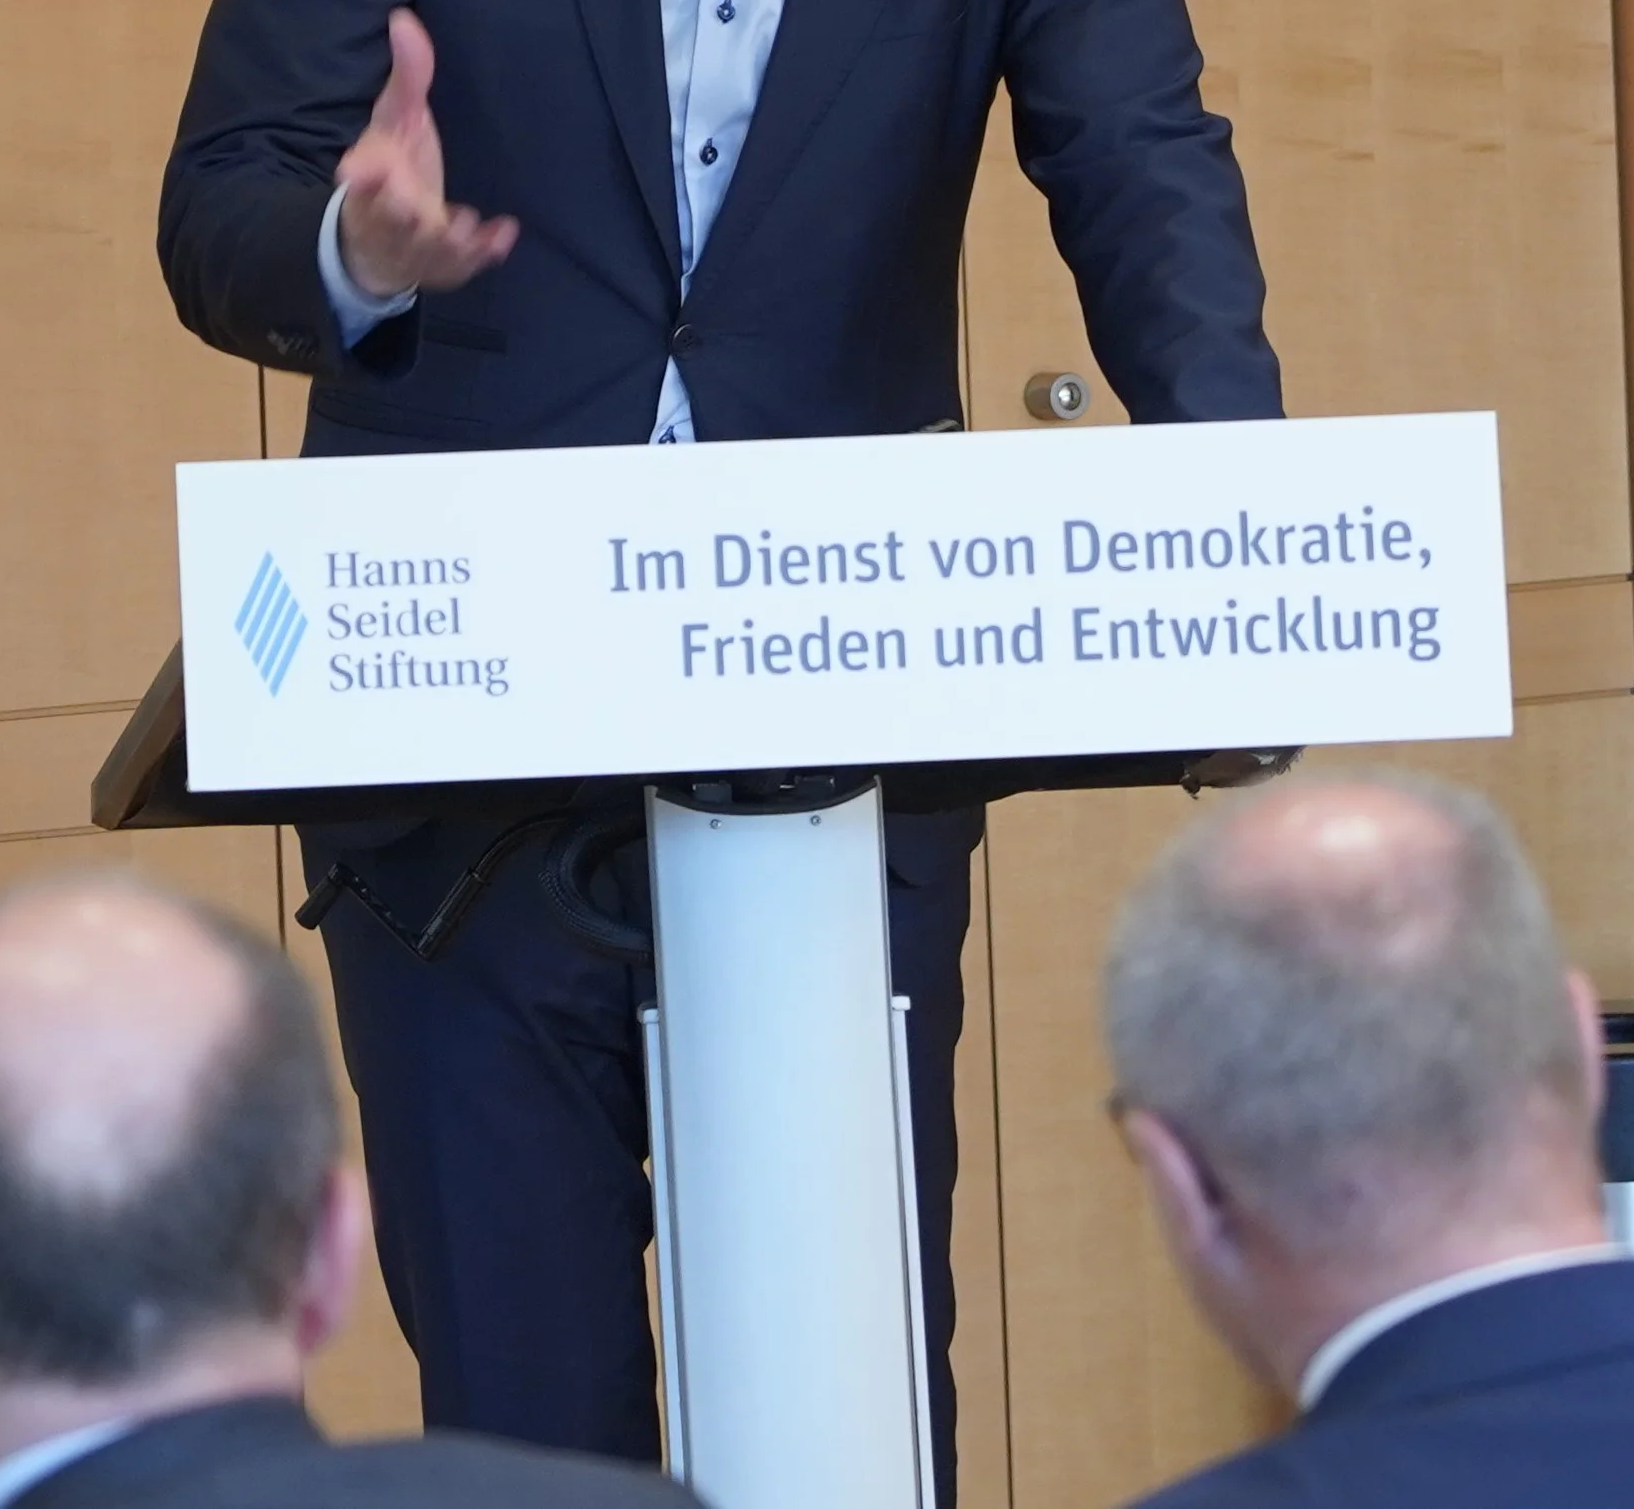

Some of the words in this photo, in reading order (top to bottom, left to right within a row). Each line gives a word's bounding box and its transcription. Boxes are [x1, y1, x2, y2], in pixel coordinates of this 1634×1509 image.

[326, 551, 472, 588] Hanns
[607, 537, 686, 593] Im
[712, 528, 906, 589] Dienst
[927, 534, 1036, 579] von
[1062, 504, 1433, 575] Demokratie,
[327, 597, 462, 639] Seidel
[680, 614, 908, 679] Frieden
[933, 605, 1045, 669] und
[1071, 594, 1442, 664] Entwicklung
[328, 649, 510, 697] Stiftung
